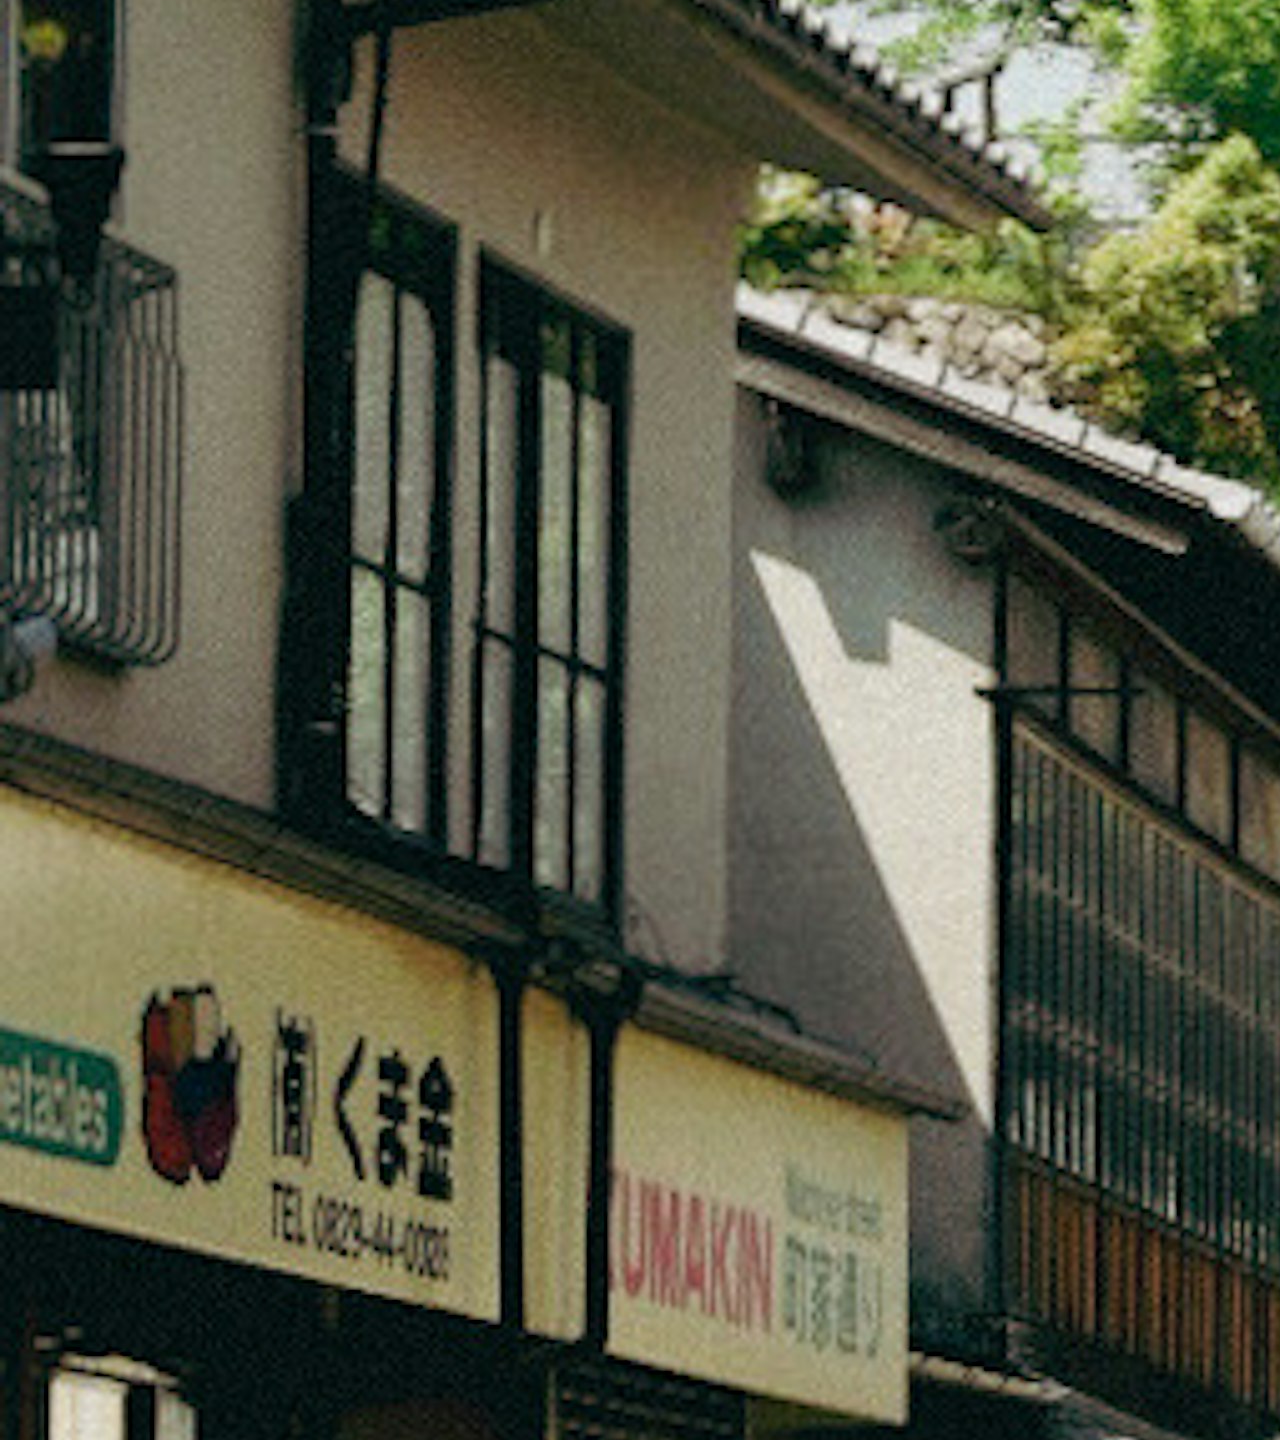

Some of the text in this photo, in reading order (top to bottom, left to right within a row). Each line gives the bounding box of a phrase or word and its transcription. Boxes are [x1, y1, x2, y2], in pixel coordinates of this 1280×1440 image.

[0, 1053, 109, 1152] etables
[273, 1181, 306, 1245] TEL
[608, 1173, 772, 1333] UMAKIN
